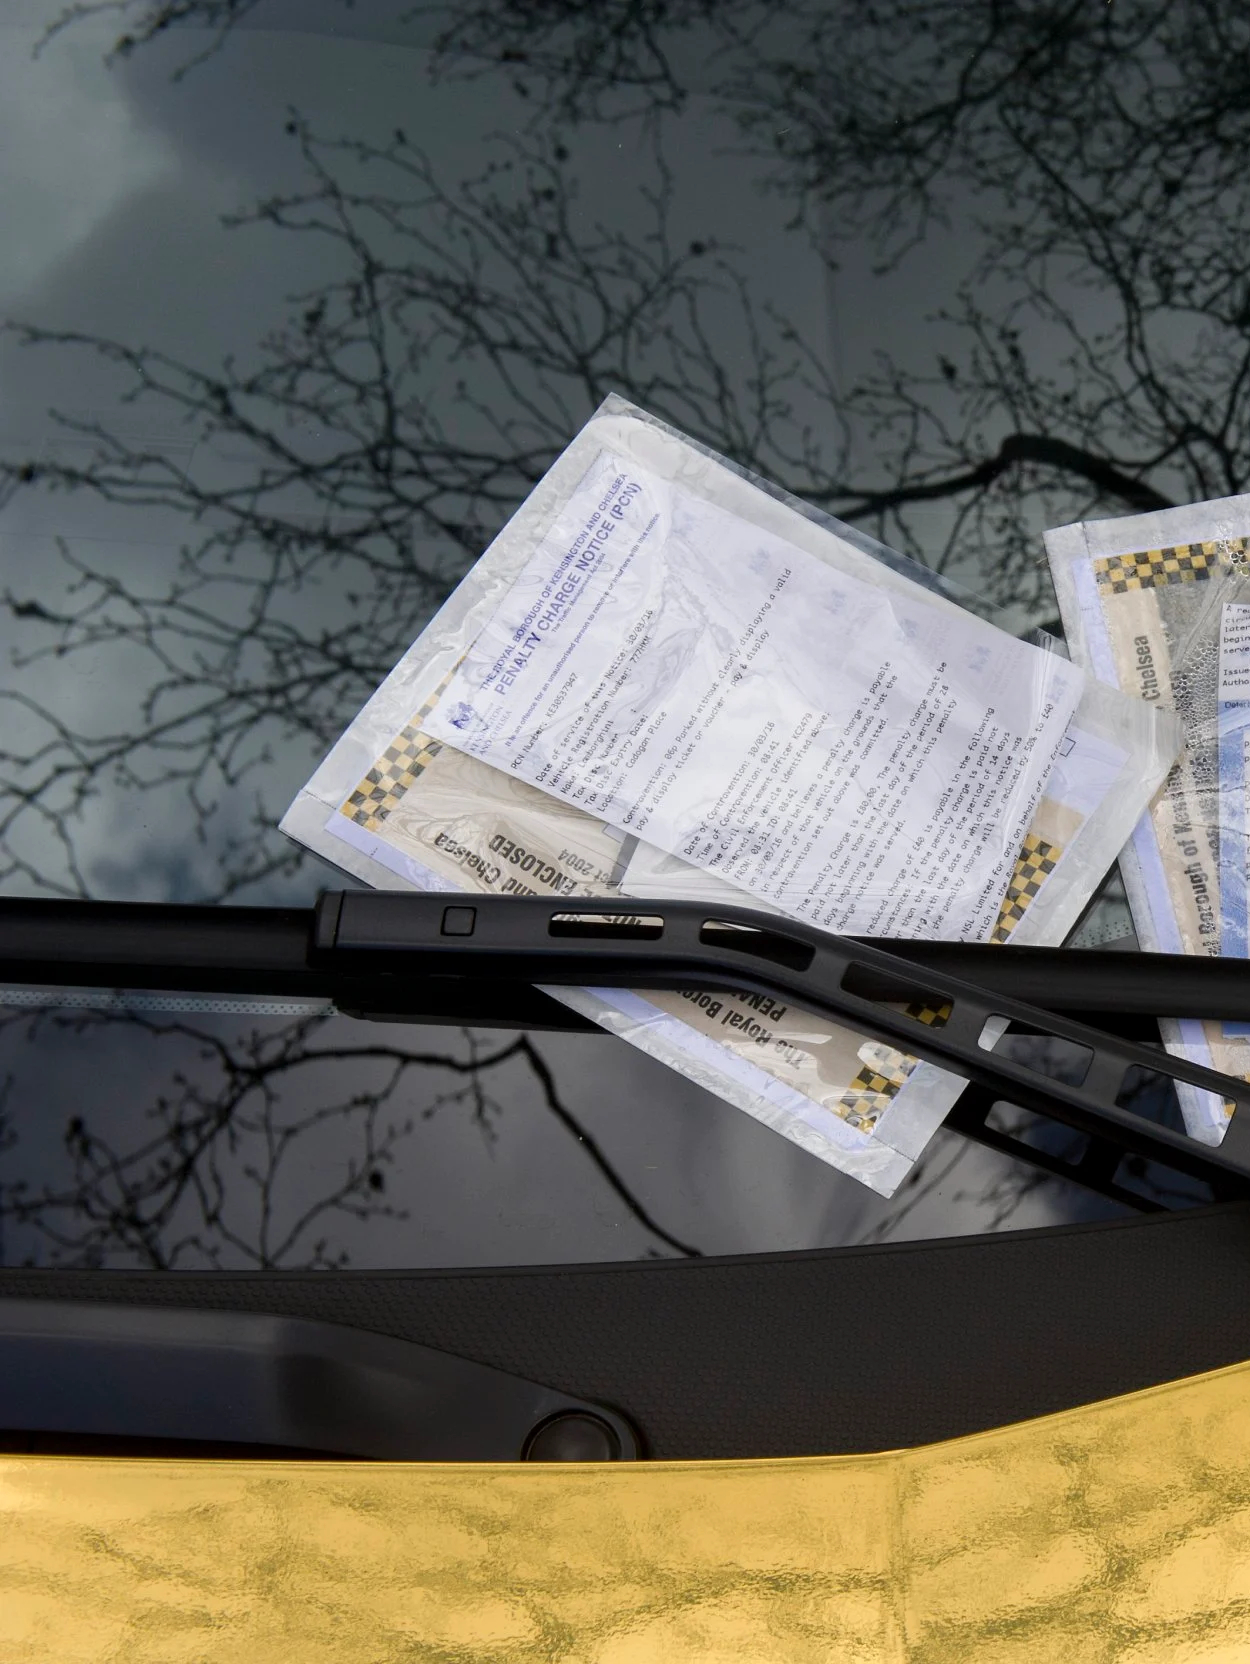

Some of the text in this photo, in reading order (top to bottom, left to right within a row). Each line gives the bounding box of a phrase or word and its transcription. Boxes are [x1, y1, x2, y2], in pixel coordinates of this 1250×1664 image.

[492, 645, 516, 674] ROYAL
[512, 599, 545, 643] BOROUGH
[541, 585, 552, 598] OF
[549, 530, 589, 585] KENSINGTON
[585, 512, 601, 531] AND
[598, 474, 628, 511] CHELSEA
[494, 482, 642, 695] PENALTY CHARGE NOTICE (PCN)
[514, 725, 522, 734] an
[520, 702, 538, 725] offence
[534, 691, 544, 701] for
[542, 683, 550, 692] an
[548, 642, 576, 682] unauthorised
[574, 621, 591, 643] person
[608, 582, 615, 590] or
[628, 544, 640, 557] with
[637, 532, 649, 544] this
[1134, 636, 1161, 701] Chelsea
[511, 754, 525, 769] PCN
[545, 672, 578, 718] KE30537947
[535, 763, 552, 782] Date
[552, 748, 560, 760] of
[560, 716, 584, 748] service
[584, 702, 591, 713] of
[604, 649, 628, 680] Notice:
[547, 635, 652, 787] Vehicle Registration Number: 777HKM
[622, 764, 666, 824] Contravention:
[664, 745, 678, 760] 06p
[675, 715, 698, 743] Parked
[696, 682, 719, 713] without
[718, 648, 741, 680] clearly
[740, 602, 771, 646] displaying
[774, 568, 791, 591] valid
[596, 712, 667, 812] Location: Cadogan Place
[683, 721, 775, 855] Date of Contravention: 30/03/16
[696, 741, 780, 860] Time of Contravention: 08:41
[708, 853, 723, 866] The
[720, 828, 740, 850] Civil
[737, 776, 773, 825] Enforcement
[770, 742, 793, 774] Officer
[434, 832, 501, 885] Chelsea
[488, 834, 578, 895] ENCLOSED
[557, 849, 594, 876] 2004
[734, 788, 798, 880] FROM: 08:31 TO: 08:41
[1177, 840, 1198, 856] of
[1184, 862, 1216, 935] Borough
[721, 1008, 773, 1046] Royal
